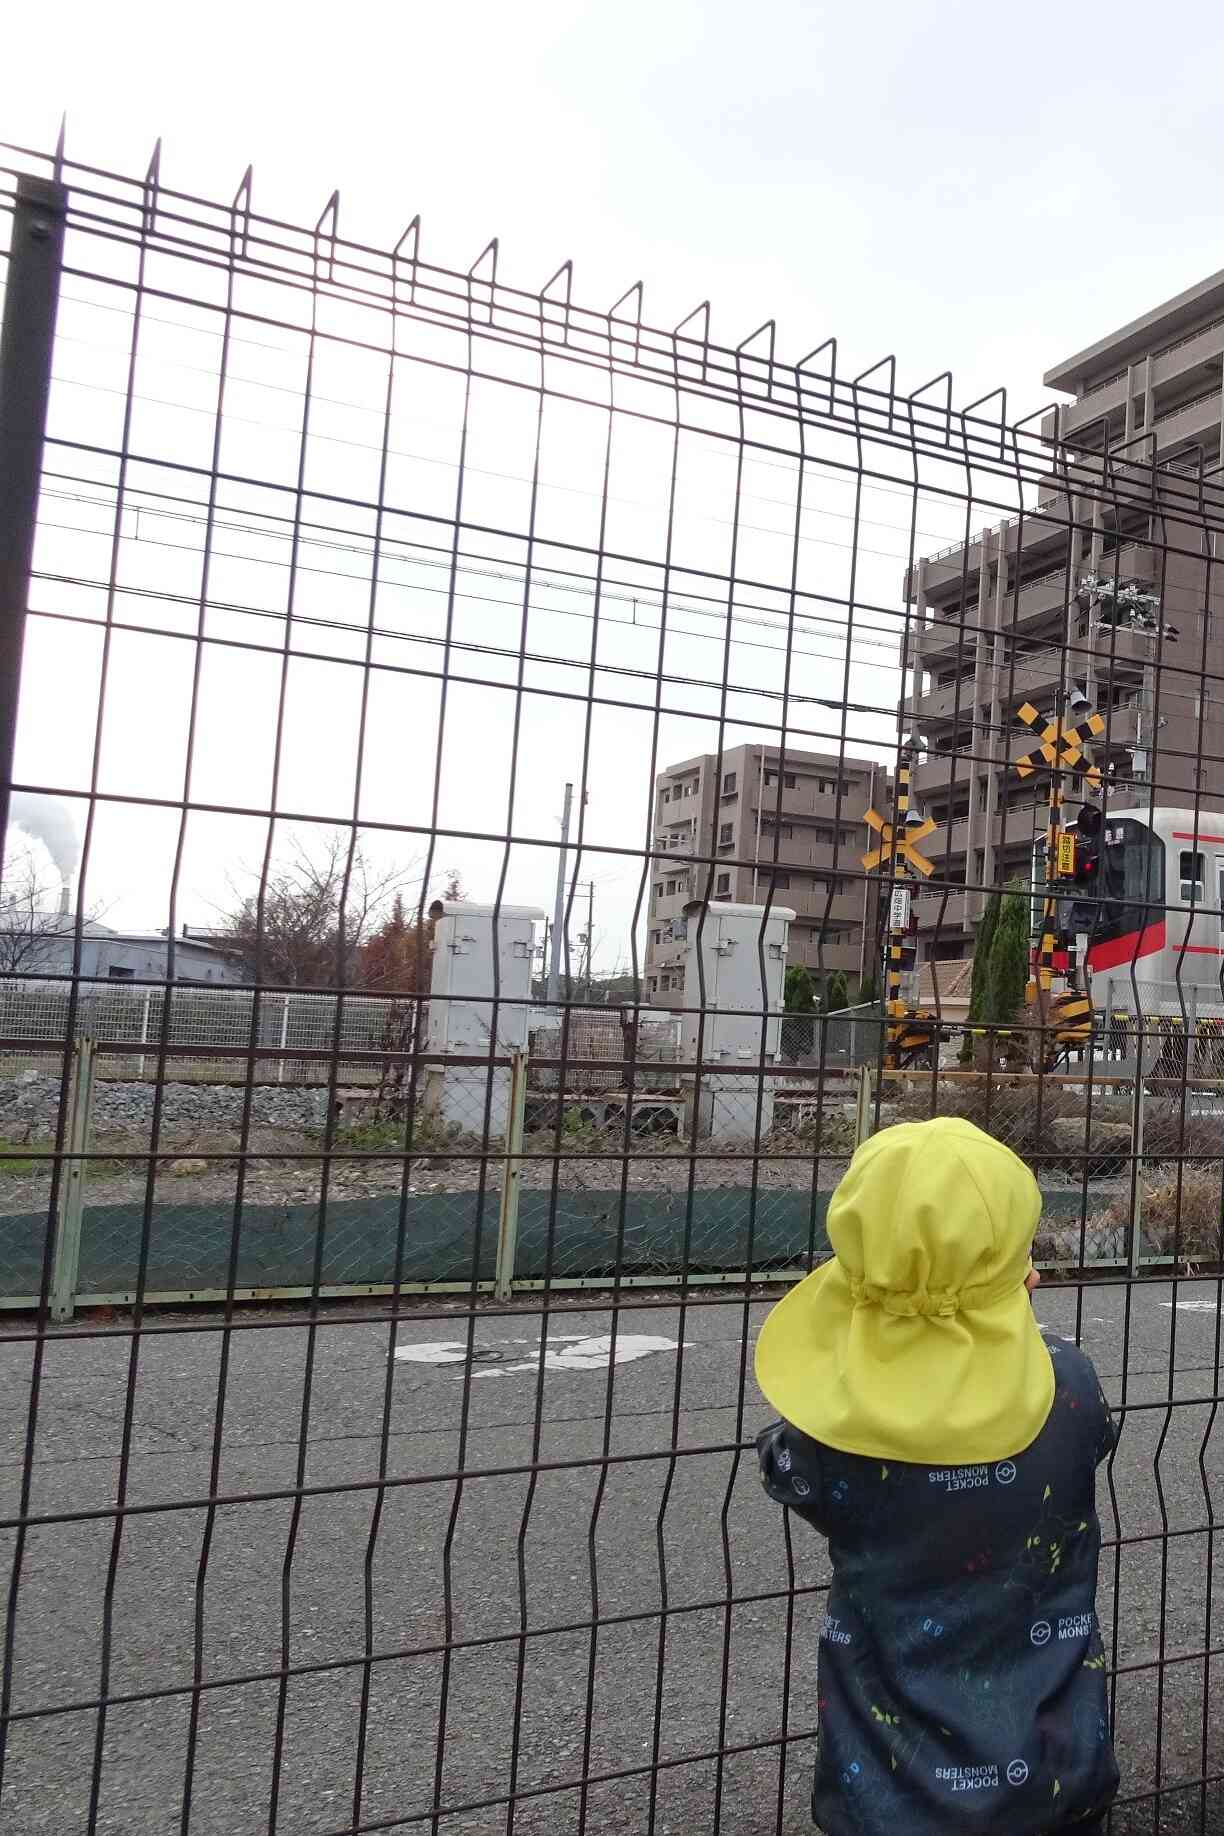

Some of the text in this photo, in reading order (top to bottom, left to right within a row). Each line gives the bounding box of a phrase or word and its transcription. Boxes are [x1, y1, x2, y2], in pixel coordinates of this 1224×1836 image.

[928, 1464, 989, 1482] MONSTERS
[945, 1475, 989, 1492] POCKET
[935, 1764, 999, 1779] MONSTERS
[951, 1775, 999, 1791] POCKET
